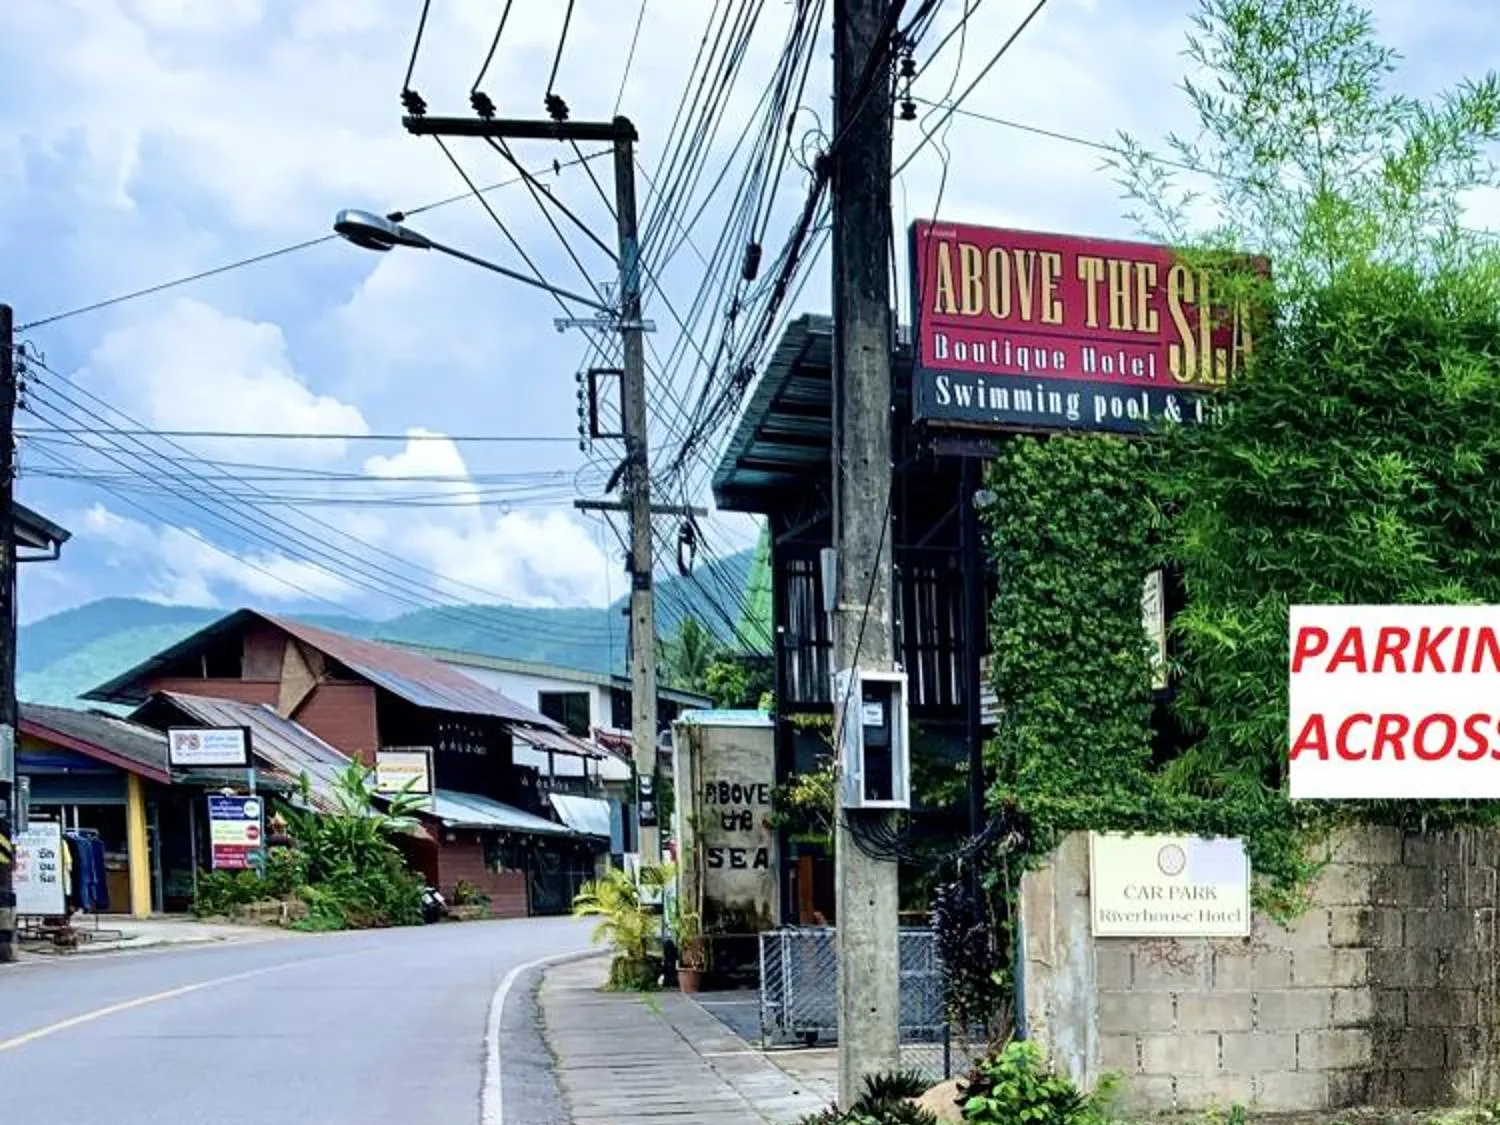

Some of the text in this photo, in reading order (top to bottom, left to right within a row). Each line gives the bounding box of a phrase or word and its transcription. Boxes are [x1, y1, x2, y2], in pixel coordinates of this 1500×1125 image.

[933, 241, 1063, 325] ABOVE
[1077, 256, 1159, 333] THE
[934, 333, 1156, 378] Boutique Hotel
[936, 376, 1080, 420] Swimming
[1095, 394, 1150, 422] pool
[1164, 394, 1183, 423] &
[704, 783, 768, 805] ABOVE
[707, 847, 769, 869] SEA
[1123, 884, 1217, 900] CAR PARK
[1100, 908, 1241, 923] Riverhouse Hotel
